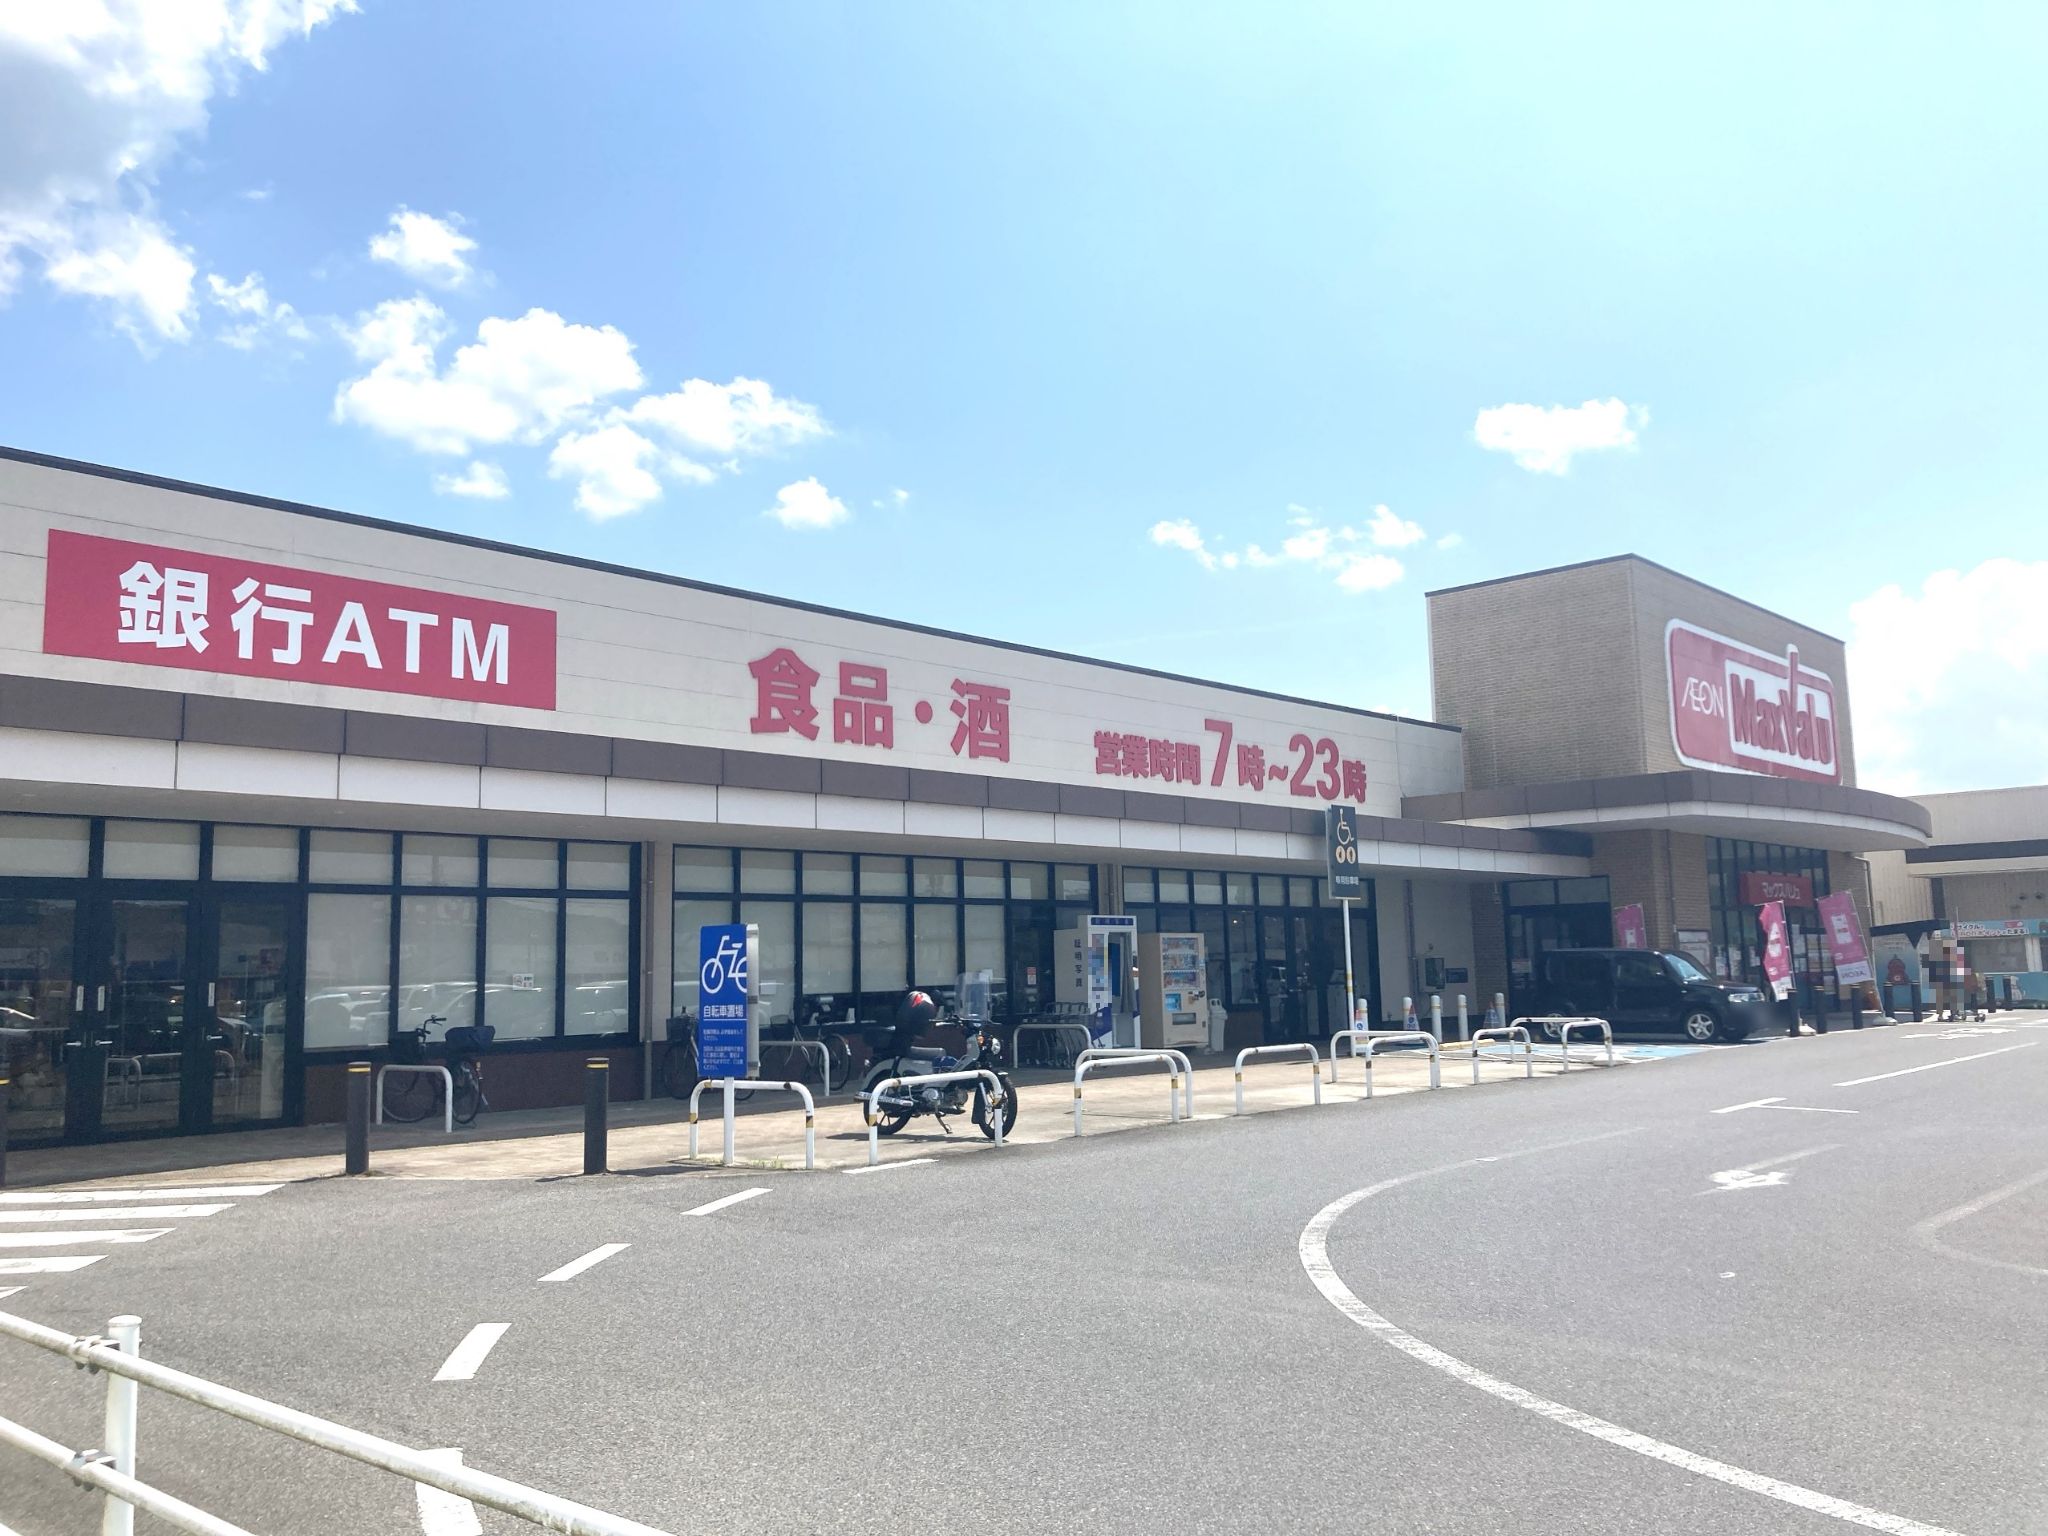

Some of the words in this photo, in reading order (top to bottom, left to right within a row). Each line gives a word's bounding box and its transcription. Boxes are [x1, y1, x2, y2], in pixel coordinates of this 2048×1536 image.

[118, 561, 509, 685] 銀行ATM
[748, 648, 1010, 763] 食品・酒
[1730, 651, 1832, 765] MaxValu
[703, 1004, 744, 1018] 自転車置場
